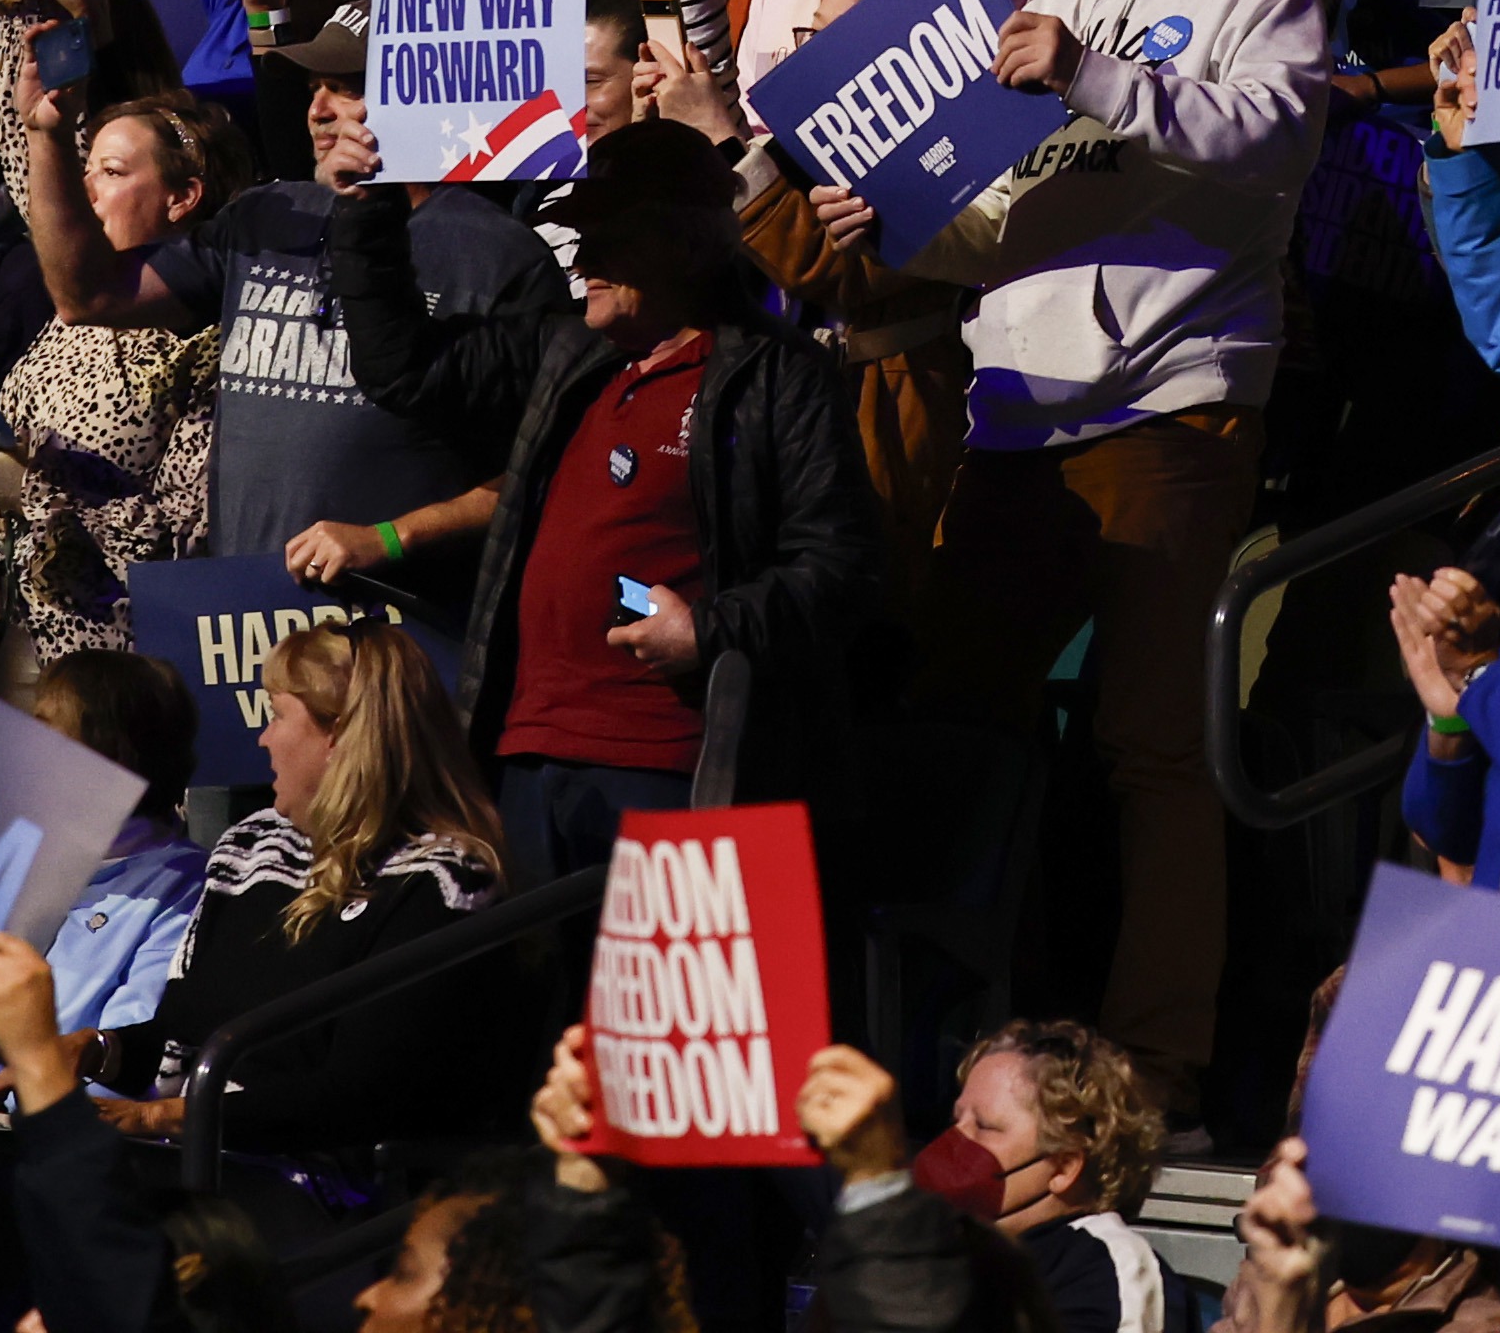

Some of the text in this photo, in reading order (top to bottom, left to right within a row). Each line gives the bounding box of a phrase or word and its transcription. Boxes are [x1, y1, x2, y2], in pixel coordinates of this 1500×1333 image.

[379, 39, 546, 107] FORWARD
[918, 136, 956, 175] HARRIS
[1056, 138, 1126, 175] PACK
